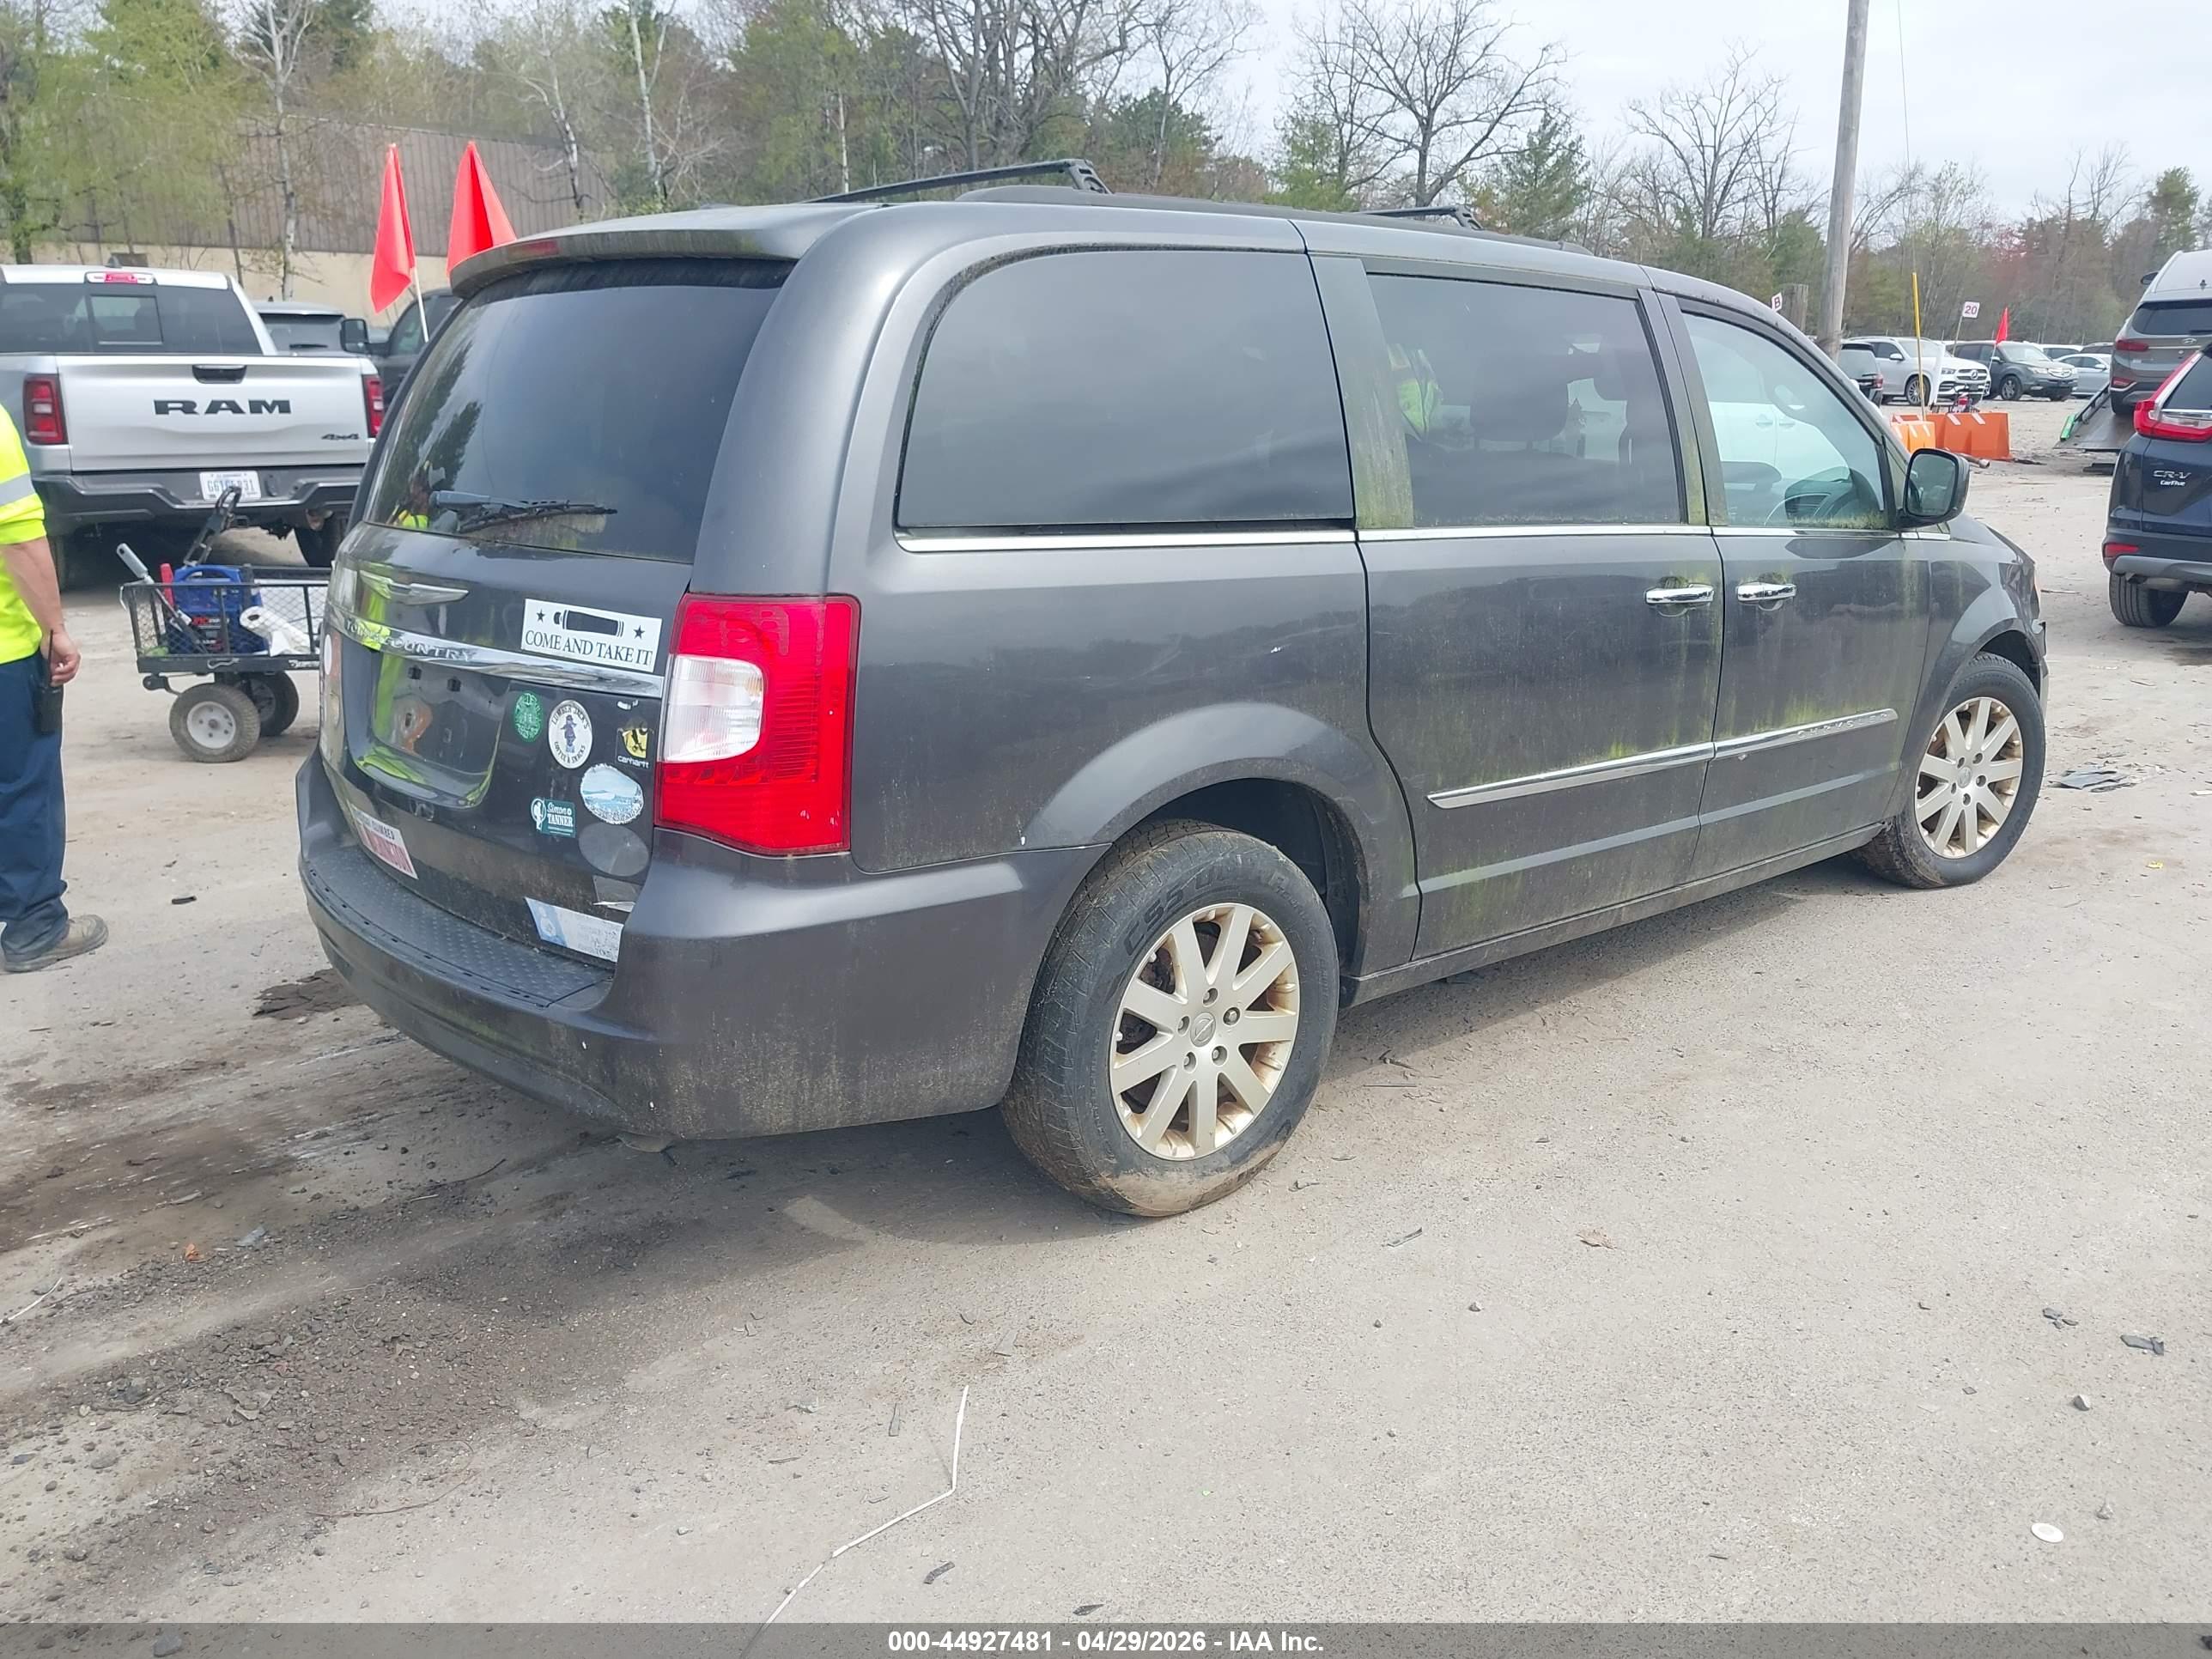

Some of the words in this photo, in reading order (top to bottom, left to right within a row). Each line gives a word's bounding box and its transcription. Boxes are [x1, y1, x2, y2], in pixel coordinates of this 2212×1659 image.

[1964, 305, 1978, 315] 20
[153, 399, 291, 416] RAM
[2153, 470, 2191, 479] CR-V
[525, 629, 562, 651] COME
[562, 637, 593, 655] AND
[596, 641, 635, 664] TAKE
[635, 649, 653, 666] IT
[547, 813, 574, 828] TANNER
